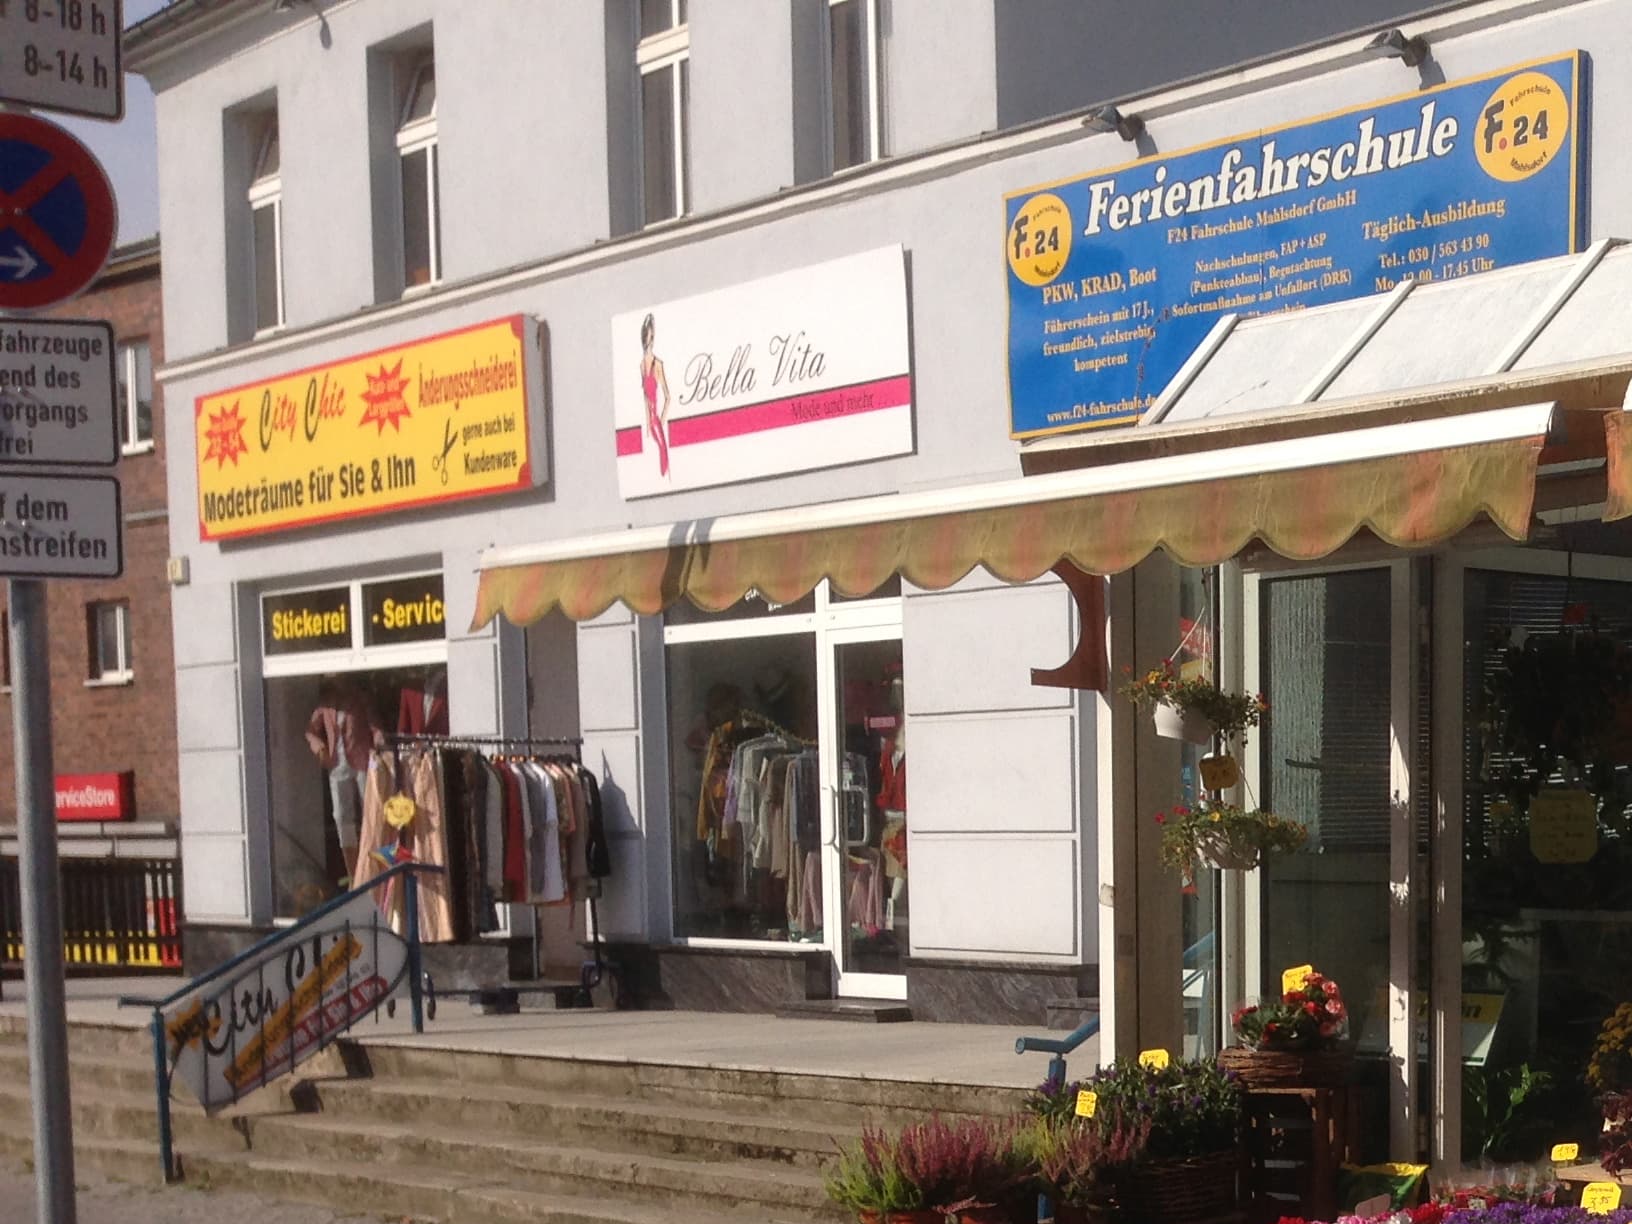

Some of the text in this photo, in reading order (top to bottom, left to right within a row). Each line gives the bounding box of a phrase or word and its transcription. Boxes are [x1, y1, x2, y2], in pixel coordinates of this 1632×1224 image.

[91, 2, 106, 35] h
[24, 44, 108, 88] 8-14 h
[1084, 100, 1458, 237] Ferienfahrschule
[1167, 189, 1357, 244] F24 Fahrschule Mahlsdorf GmbH
[1361, 198, 1506, 242] Täglich-Ausbildung
[1195, 248, 1279, 273] Nachschulungen,
[1306, 232, 1327, 249] ASP
[1269, 256, 1332, 280] Begutachtung
[1378, 252, 1405, 269] Tel.:
[1408, 246, 1429, 264] 030
[1438, 240, 1458, 259] 563
[1460, 236, 1473, 252] 43
[1475, 233, 1490, 249] 90
[1042, 267, 1157, 305] PKW, KRAD, Boot
[1258, 289, 1273, 301] am
[1275, 279, 1317, 298] Unfallort
[1320, 268, 1352, 291] (DRK)
[1375, 276, 1396, 292] Mo
[1403, 269, 1432, 281] 1200
[1442, 261, 1469, 279] 17.45
[1471, 256, 1495, 272] Uhr
[1044, 311, 1110, 334] Führerschein
[1112, 306, 1129, 321] mit
[1043, 334, 1098, 356] freundlich,
[1073, 353, 1129, 373] kompetent
[44, 363, 81, 389] des
[418, 350, 519, 411] Änderungsschneiderei
[679, 331, 827, 405] Bella Vita
[259, 388, 298, 453] City
[304, 372, 347, 443] Chic
[823, 393, 844, 414] und
[462, 412, 515, 446] gerne auch bei
[463, 449, 518, 475] Kundenware
[204, 453, 416, 523] Modeträume für Sie & Ihn
[16, 493, 68, 521] dem
[272, 604, 346, 640] Stickerei
[382, 592, 447, 630] Servic
